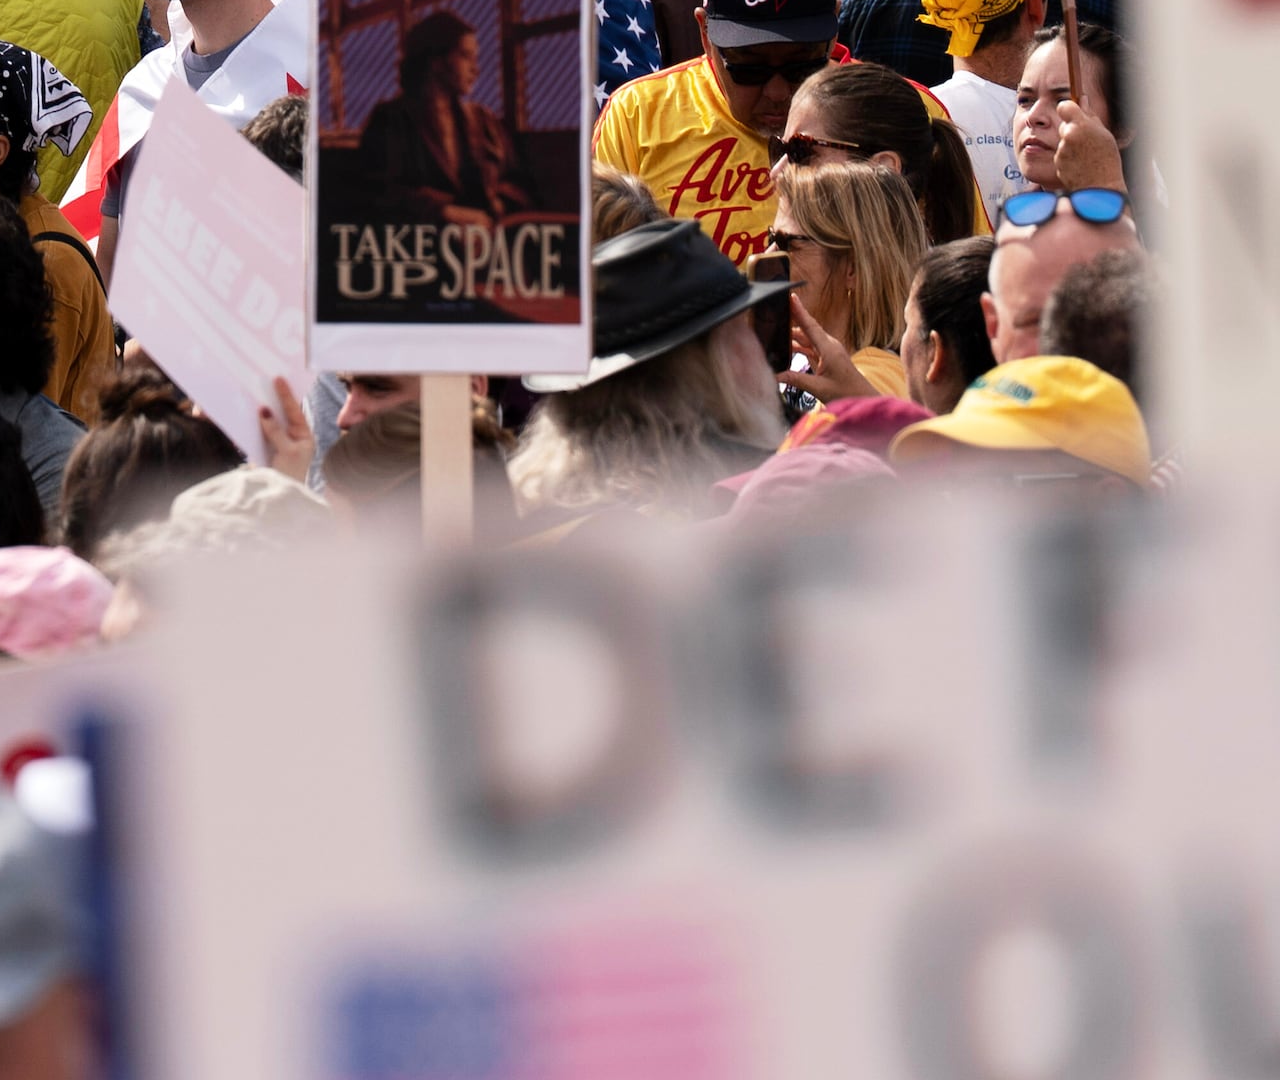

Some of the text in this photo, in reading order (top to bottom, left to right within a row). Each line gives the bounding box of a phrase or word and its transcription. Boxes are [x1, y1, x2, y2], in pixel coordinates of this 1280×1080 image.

[331, 224, 438, 263] TAKE
[335, 222, 565, 301] UP SPACE
